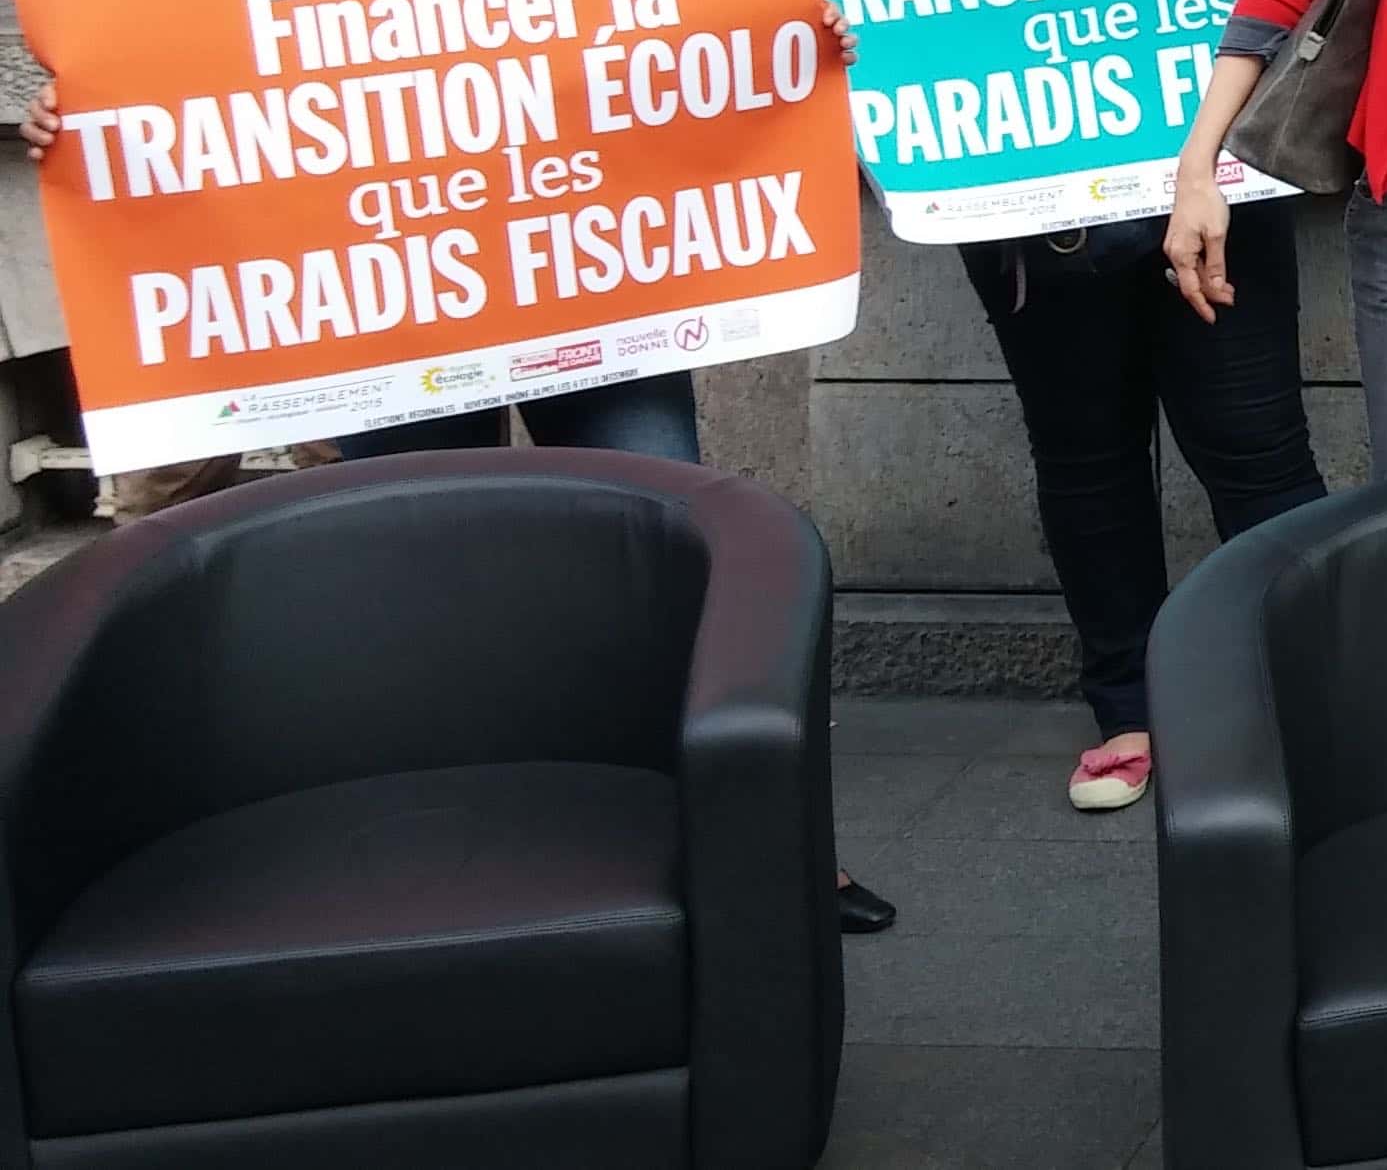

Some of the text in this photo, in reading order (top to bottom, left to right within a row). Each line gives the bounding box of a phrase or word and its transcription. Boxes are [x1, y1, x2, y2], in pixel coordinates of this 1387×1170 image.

[1025, 3, 1138, 63] que
[62, 21, 815, 203] TRANSITION ÉCOLO
[848, 56, 1141, 164] PARADIS
[350, 146, 603, 239] que les
[132, 172, 815, 365] PARADIS FISCAUX
[616, 338, 670, 358] DONNE
[248, 380, 393, 413] RASSEMBLEMENT
[349, 397, 384, 413] 2015
